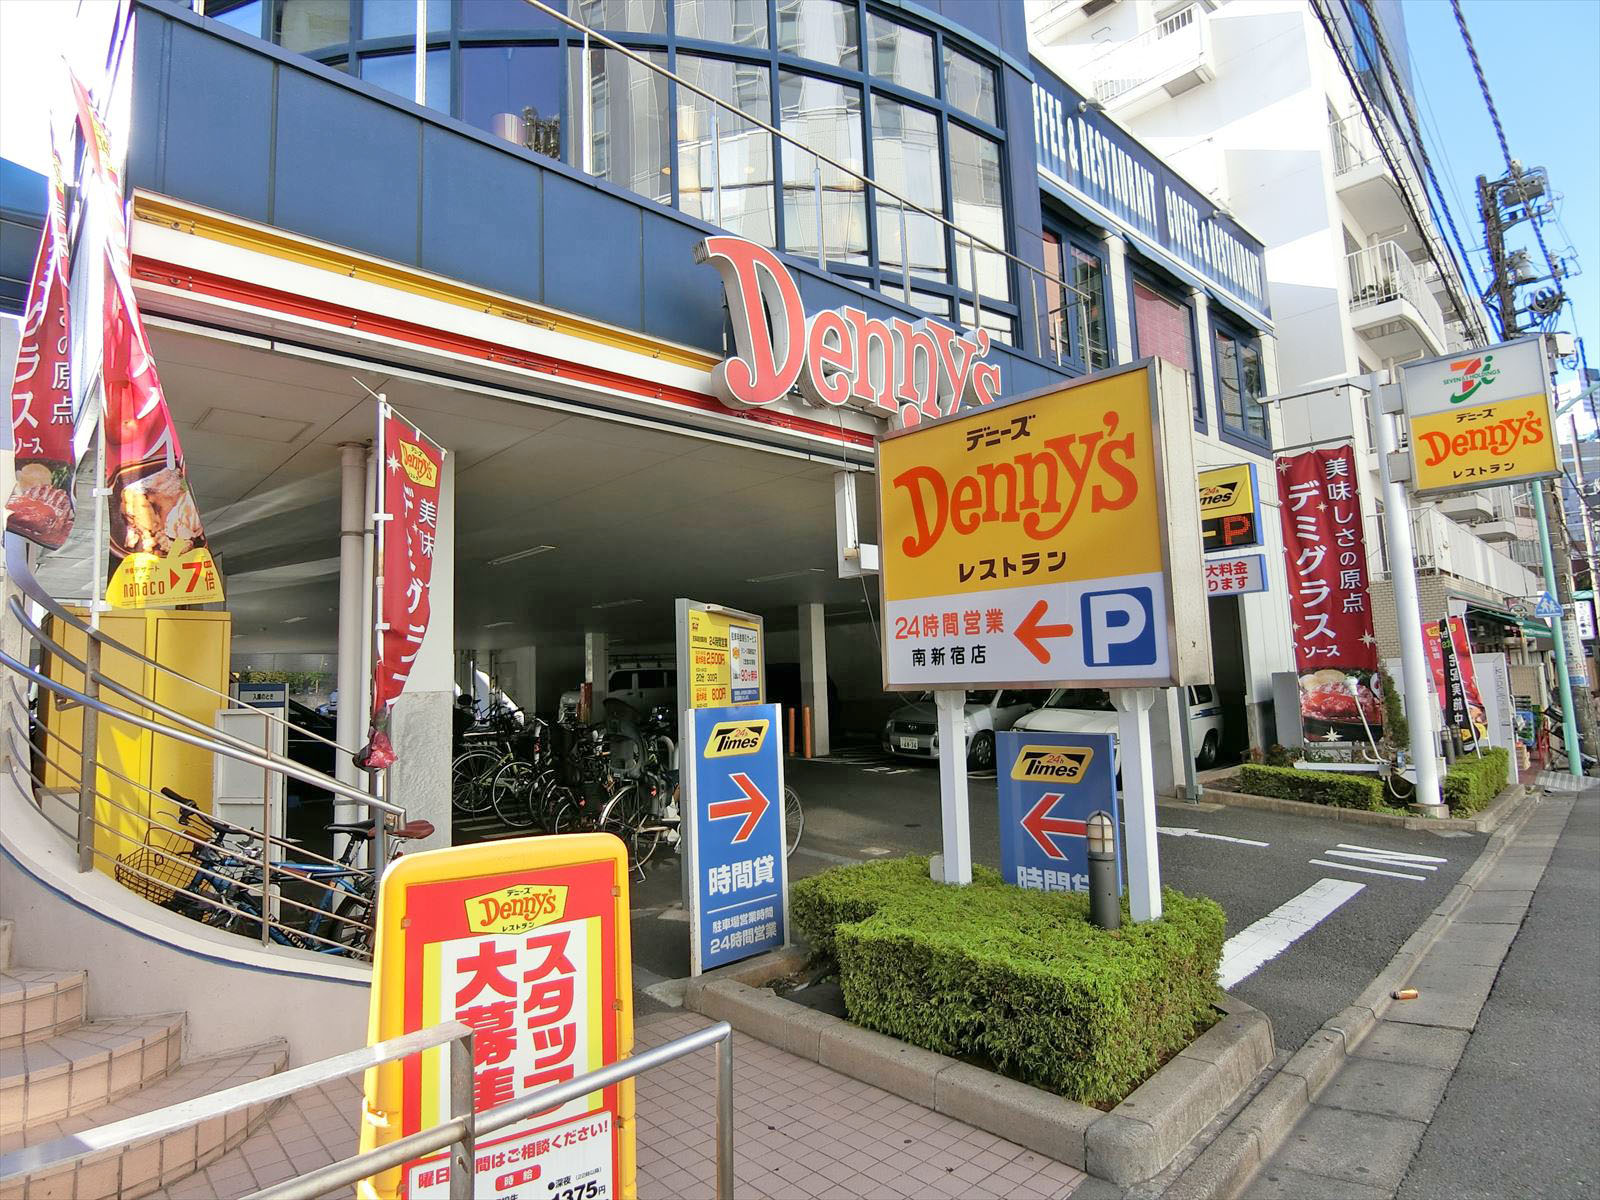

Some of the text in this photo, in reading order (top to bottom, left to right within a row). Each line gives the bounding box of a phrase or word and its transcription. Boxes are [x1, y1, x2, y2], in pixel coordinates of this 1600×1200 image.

[1032, 82, 1158, 227] FFEE & RESTAURANT
[1165, 185, 1203, 259] COFFEE
[1208, 218, 1263, 301] RESTAURANT
[704, 236, 1001, 428] Denny's
[1456, 408, 1496, 423] デニーズ
[966, 414, 1036, 452] デニーズ
[1418, 411, 1544, 467] Denny's
[893, 411, 1138, 558] Denny's
[1453, 462, 1515, 479] レストラン
[1223, 515, 1251, 546] P
[1324, 457, 1364, 614] 美味しさの原点
[959, 551, 1067, 583] レストラン
[1205, 560, 1248, 578] 大料金
[1288, 480, 1336, 641] デミグラス
[123, 580, 165, 598] nanaco
[1208, 576, 1249, 592] ります
[895, 607, 1004, 640] 24時間営業
[1089, 593, 1146, 664] P
[912, 644, 987, 667] 南新宿店
[1303, 644, 1341, 659] ソース
[714, 730, 759, 752] Times
[1023, 757, 1080, 777] Times
[708, 855, 775, 897] 時間貸
[478, 888, 556, 927] Denny's
[506, 886, 533, 898] デニーズ
[501, 921, 535, 933] レストラン
[712, 906, 774, 935] 駐車場営業時間
[709, 921, 777, 955] 24時間営業
[555, 1176, 571, 1188] 深夜
